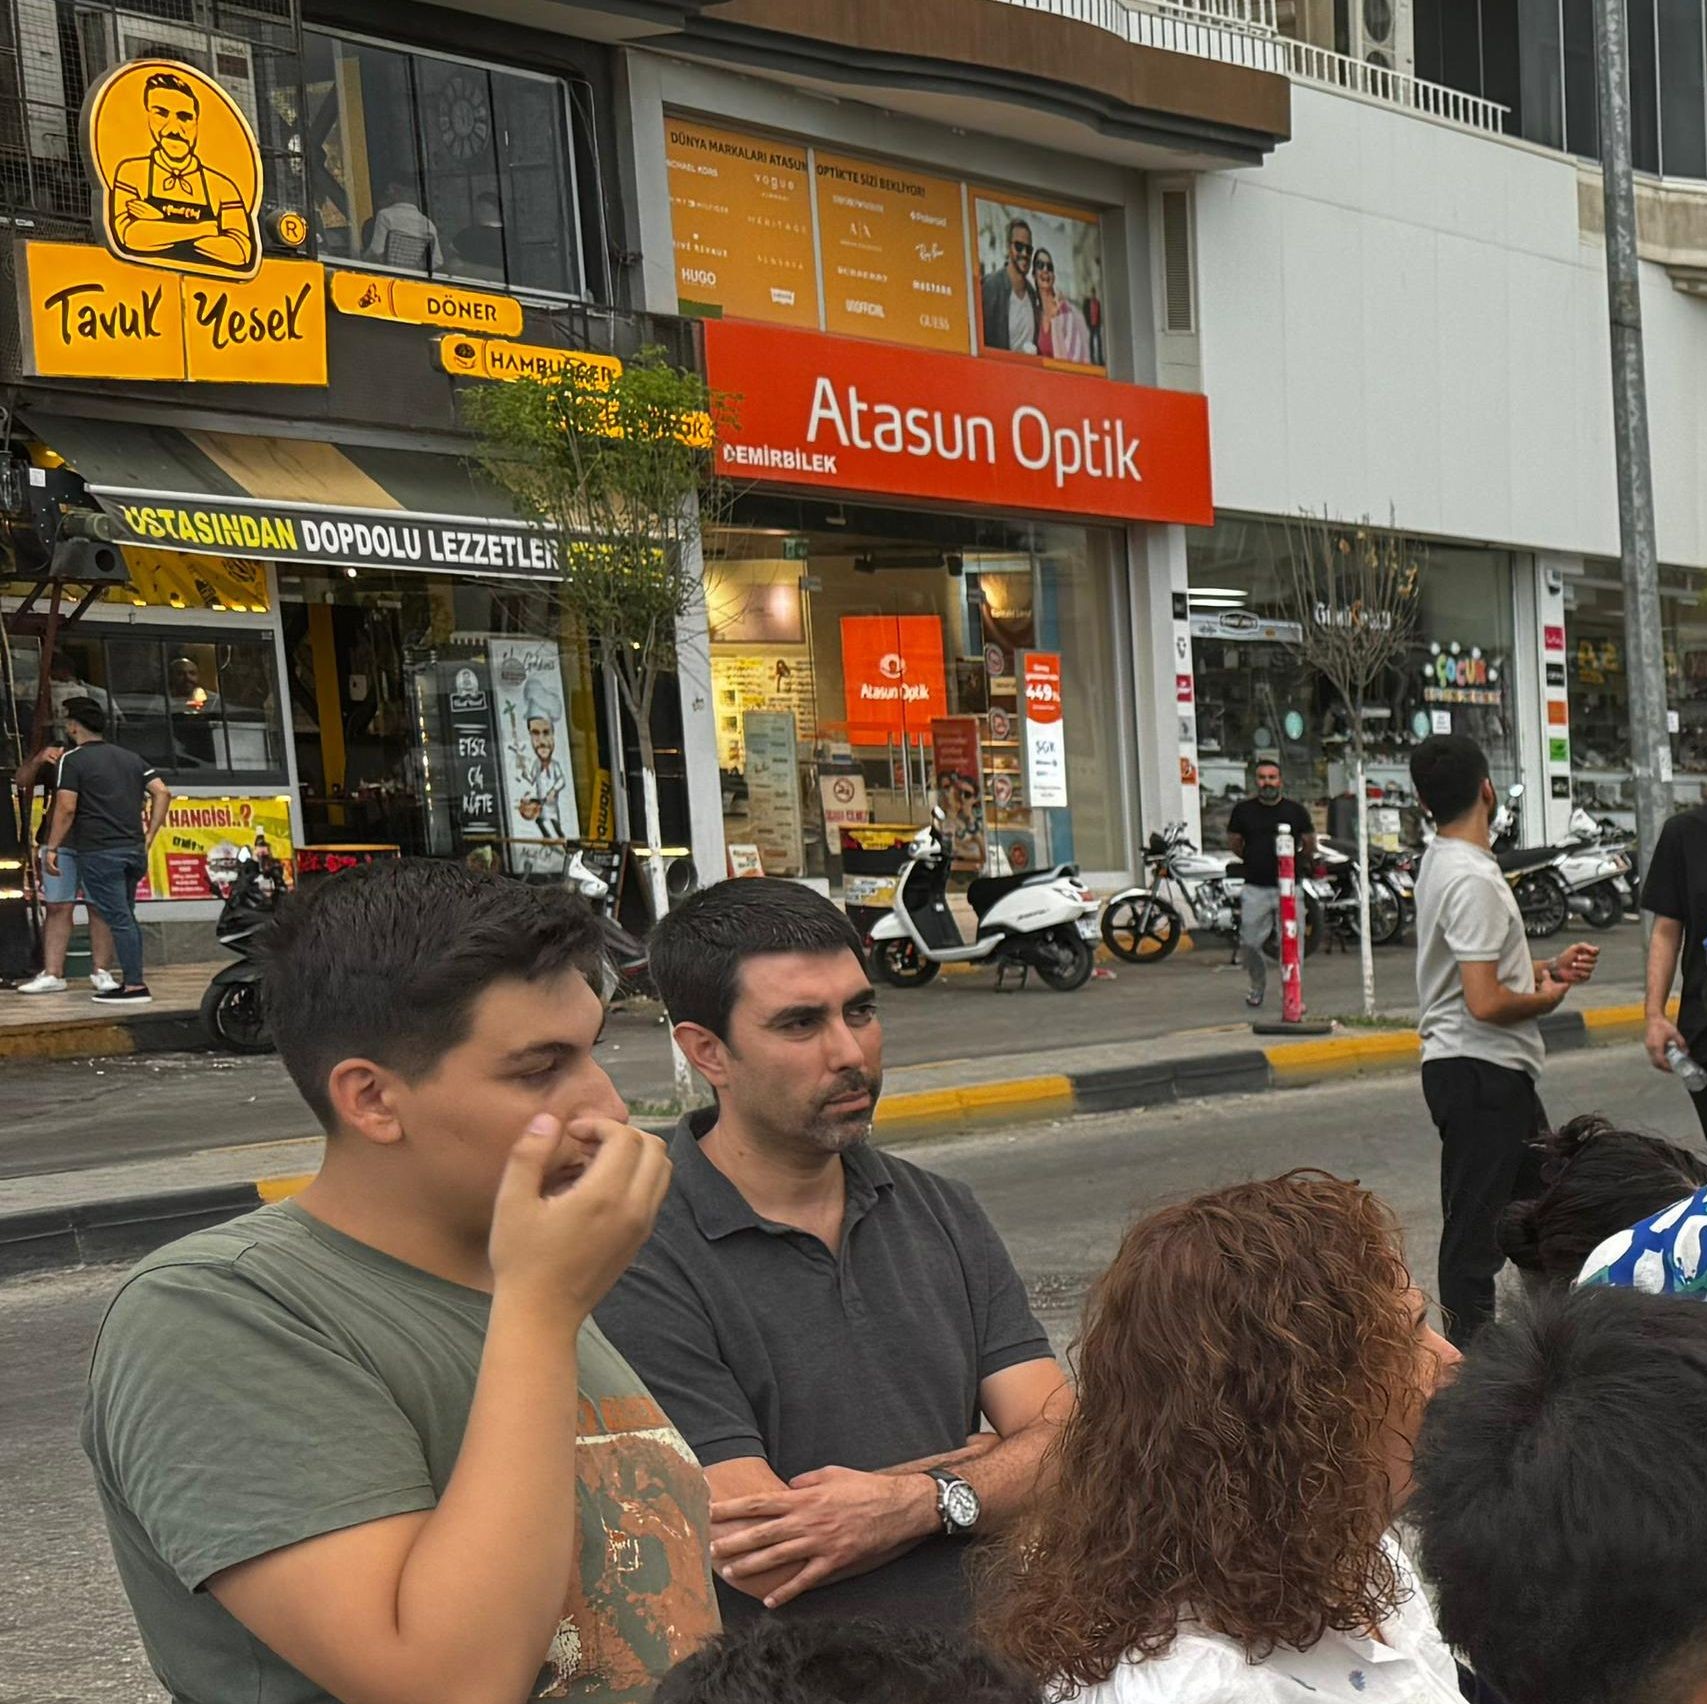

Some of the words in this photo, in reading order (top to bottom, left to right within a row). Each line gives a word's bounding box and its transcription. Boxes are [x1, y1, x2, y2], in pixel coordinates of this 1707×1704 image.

[671, 131, 707, 150] DÜNYA
[708, 141, 768, 163] MARKALARI
[681, 267, 717, 285] HUGO
[426, 294, 498, 323] DÖNER
[806, 376, 996, 464] Atasun
[1011, 405, 1142, 488] Optik
[723, 442, 838, 475] DEMİRBİLEK
[301, 519, 422, 561] DOPDOLU
[860, 682, 898, 701] Atasun
[1026, 683, 1053, 702] 449
